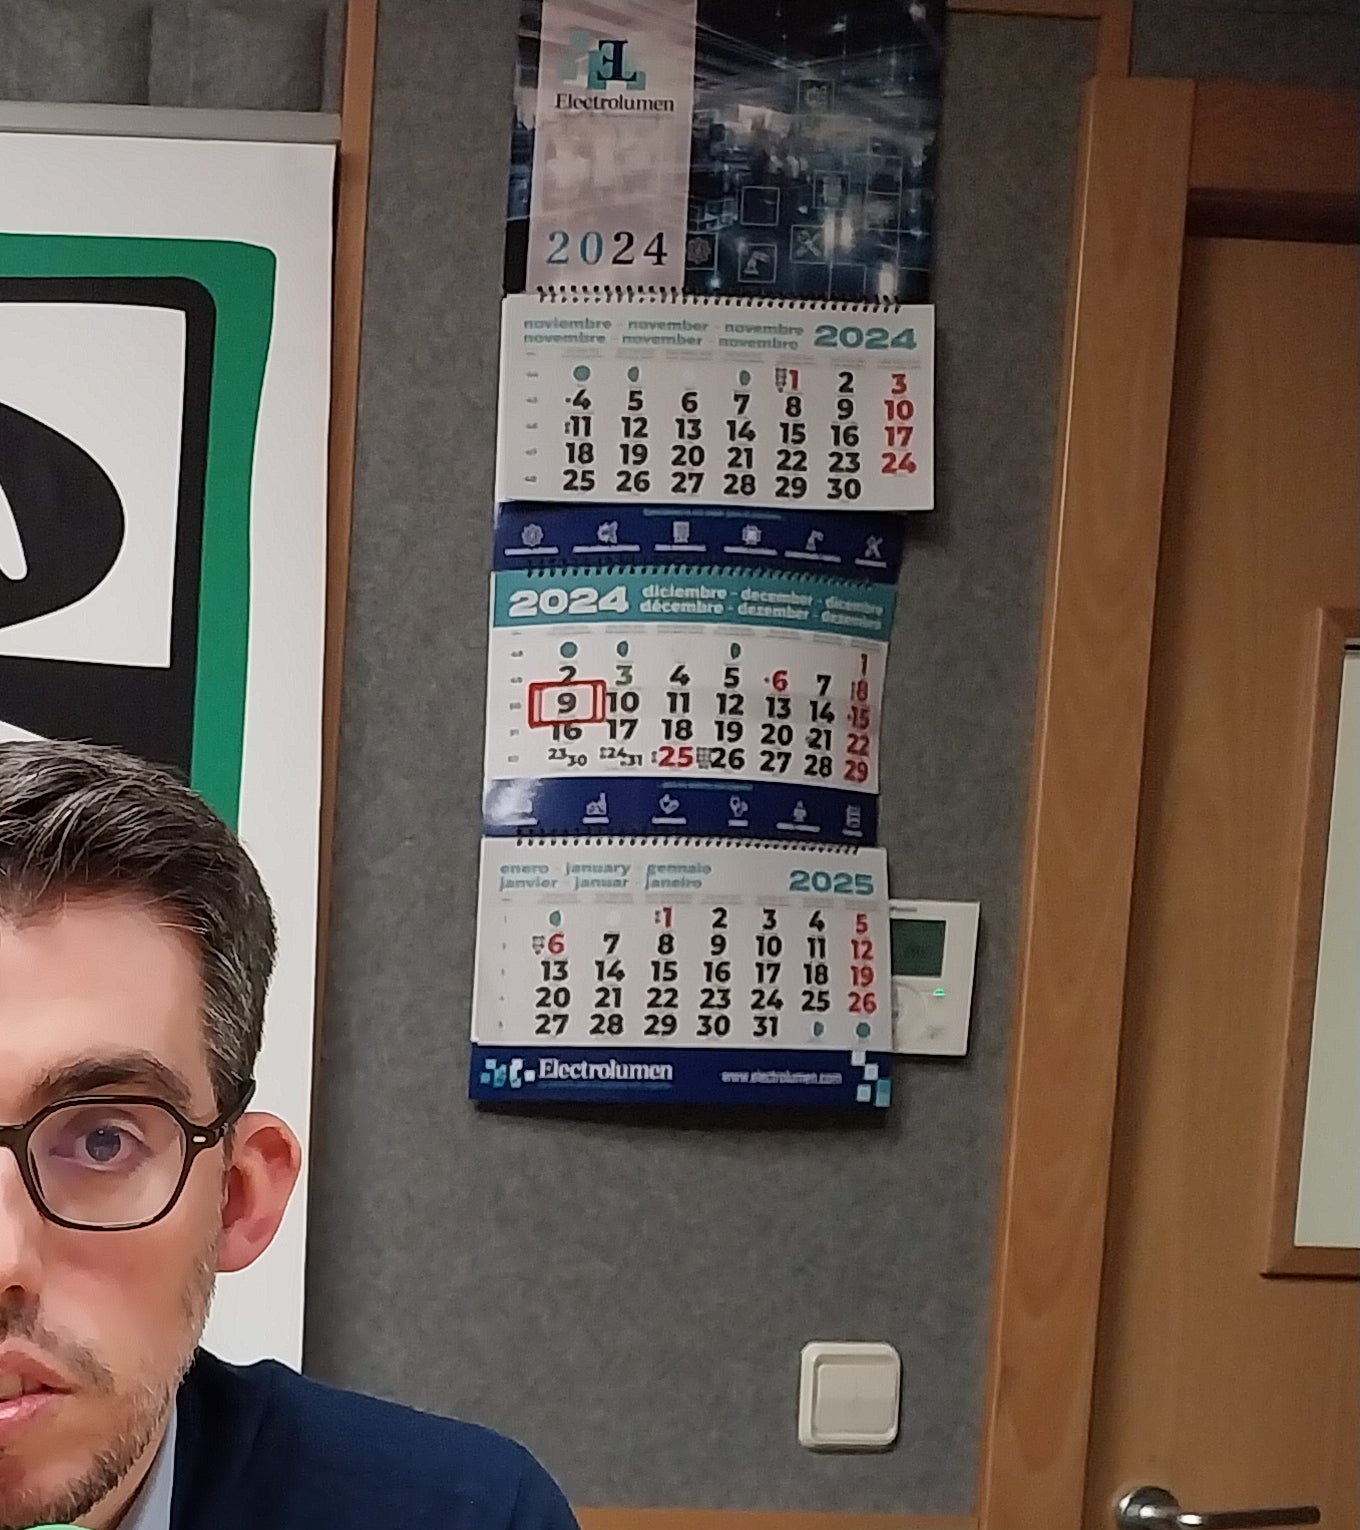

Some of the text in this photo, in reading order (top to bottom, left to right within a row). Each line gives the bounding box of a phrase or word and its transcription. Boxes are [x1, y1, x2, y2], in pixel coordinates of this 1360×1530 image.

[554, 92, 675, 112] Electrolumen
[547, 230, 668, 266] 2024
[628, 321, 709, 333] november
[814, 325, 917, 350] 2024
[788, 369, 799, 391] 1
[838, 371, 854, 394] 2
[891, 373, 907, 395] 3
[572, 388, 914, 421] 4 5 6 7 8 9 10
[569, 415, 914, 448] 11 12 13 14 15 16 17
[565, 442, 917, 475] 18 19 20 21 22 23 24
[562, 468, 862, 500] 25 26 27 28 29 30
[509, 586, 629, 617] 2024
[642, 585, 727, 600] diciembre
[860, 653, 868, 677] 1
[560, 664, 869, 704] 2 3 4 5 6 7 8
[557, 691, 870, 731] 9 10 11 12 13 14 15
[553, 718, 870, 757] 16 17 18 19 20 21 22
[548, 748, 568, 761] 23
[567, 751, 587, 766] 30
[658, 745, 694, 768] 25
[707, 747, 745, 770] 26
[759, 749, 793, 774] 27
[804, 754, 833, 779] 28
[843, 759, 869, 784] 29
[500, 864, 549, 874] enero
[565, 862, 630, 877] january
[789, 870, 874, 895] 2025
[500, 876, 558, 891] janvier
[573, 876, 629, 890] januar
[662, 906, 868, 936] 1 2 3 4 5
[547, 932, 565, 955] 6
[603, 933, 621, 955] 7
[657, 933, 675, 956] 8
[710, 934, 727, 956] 9
[755, 935, 783, 957] 10
[806, 936, 826, 960] 11
[850, 938, 874, 961] 12
[540, 959, 875, 988] 13 14 15 16 17 18 19
[535, 986, 877, 1014] 20 21 22 23 24 25 26
[534, 1013, 779, 1038] 27 28 29 30 31
[539, 1058, 673, 1080] Electrolumen
